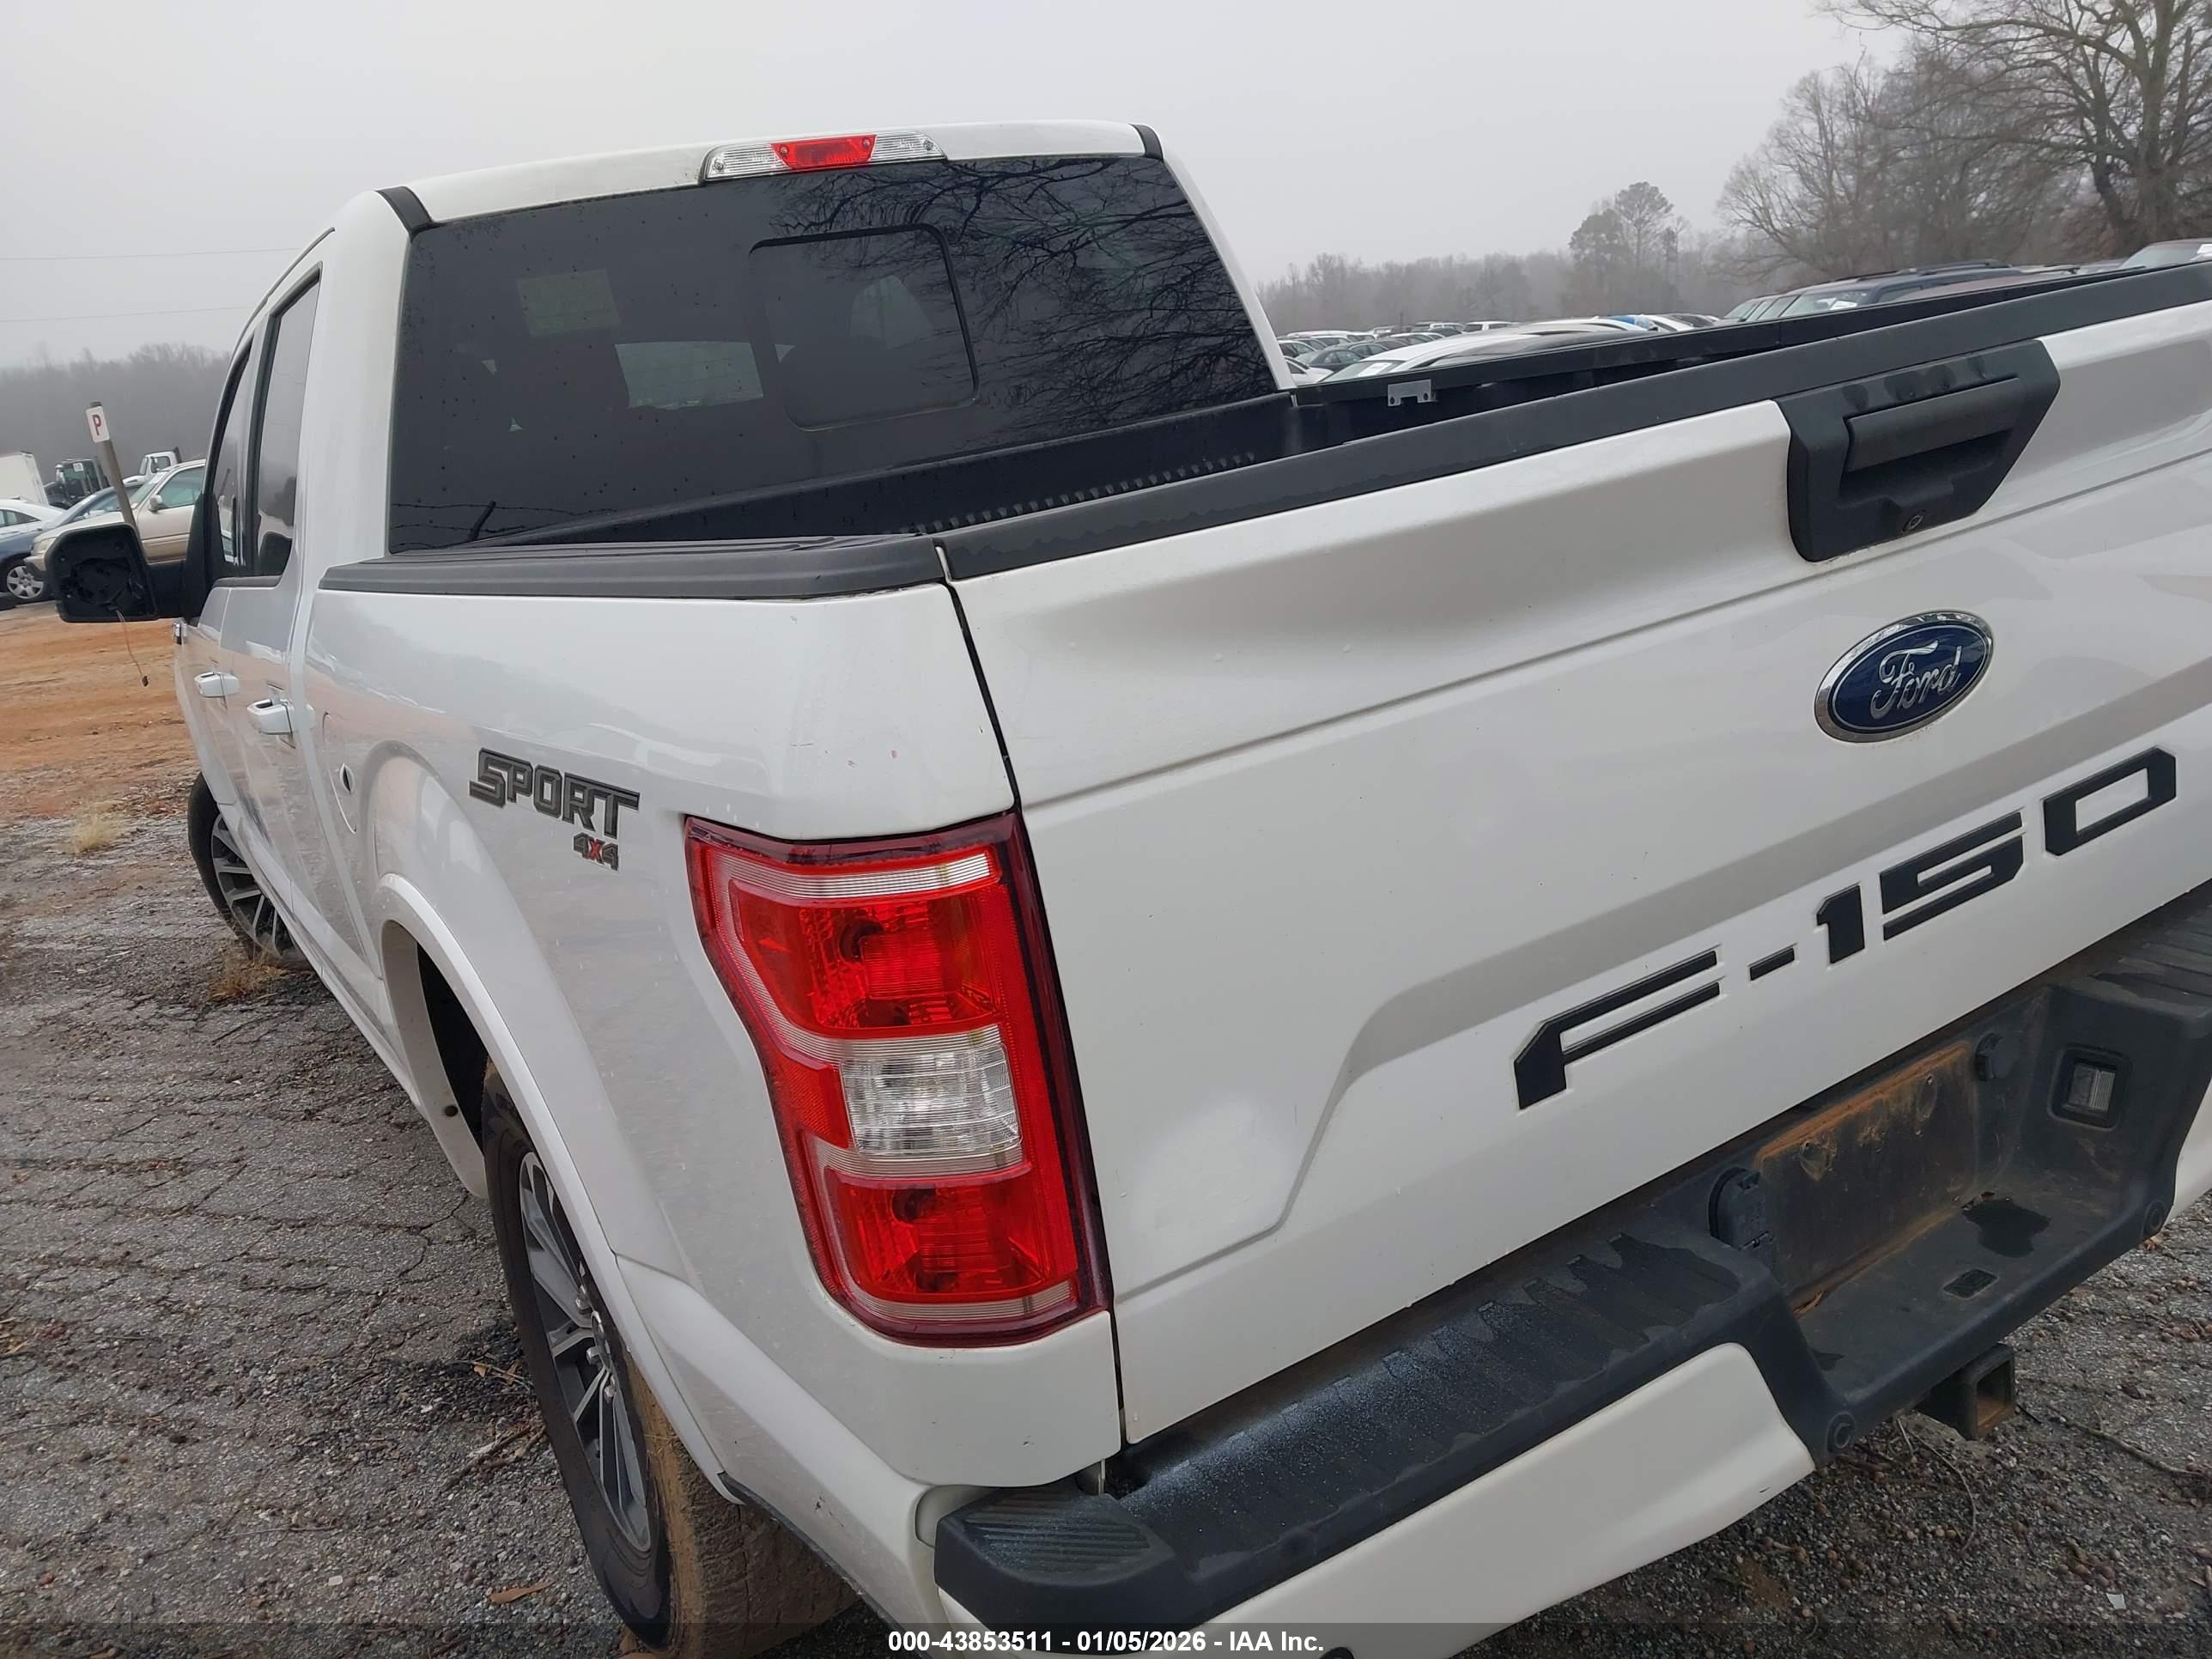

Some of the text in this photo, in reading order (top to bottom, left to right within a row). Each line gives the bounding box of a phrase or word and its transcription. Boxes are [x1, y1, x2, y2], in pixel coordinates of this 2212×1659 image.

[92, 414, 101, 436] P
[1869, 639, 1963, 720] Ford
[469, 747, 641, 840] SPORT
[1513, 745, 2178, 1111] F-150
